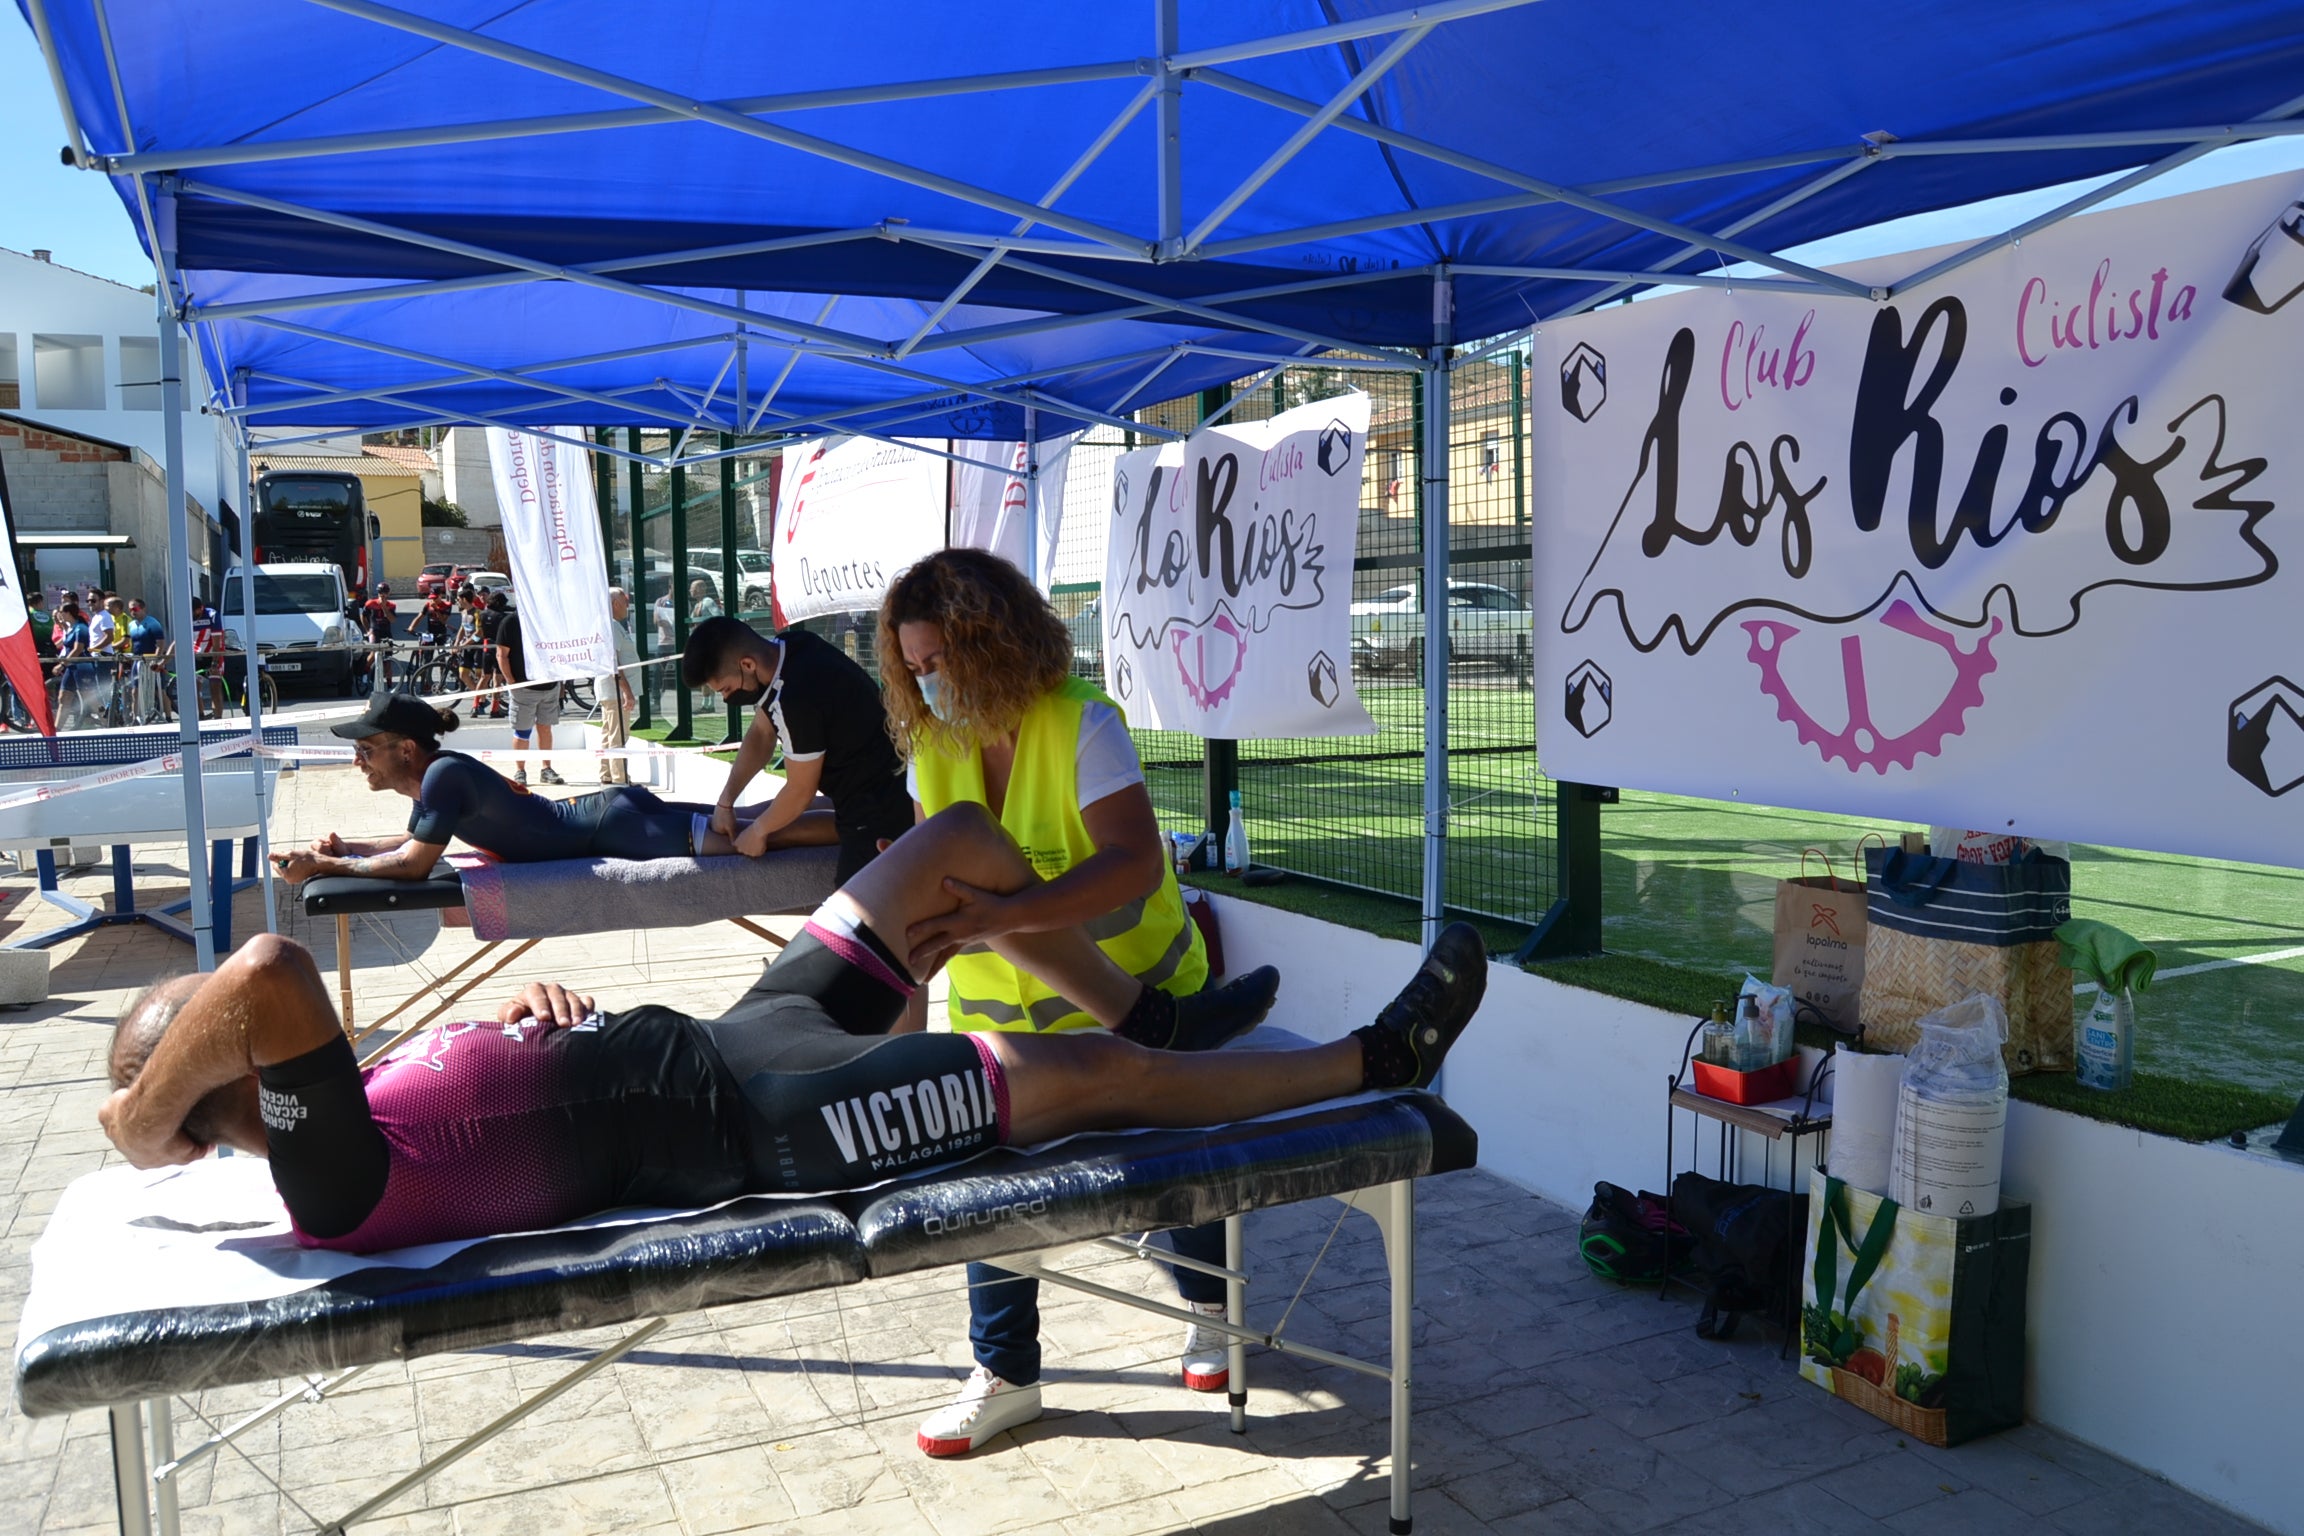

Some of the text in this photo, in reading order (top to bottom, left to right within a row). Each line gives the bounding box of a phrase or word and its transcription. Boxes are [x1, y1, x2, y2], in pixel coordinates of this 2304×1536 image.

[1720, 257, 2196, 411] Club Ciclista
[1640, 295, 2186, 579] Los Rios
[1195, 452, 1304, 598] Rios
[800, 556, 886, 601] Deportes
[97, 766, 147, 785] DEPORTES
[820, 1067, 998, 1165] VICTORIA
[948, 1132, 983, 1150] 1928
